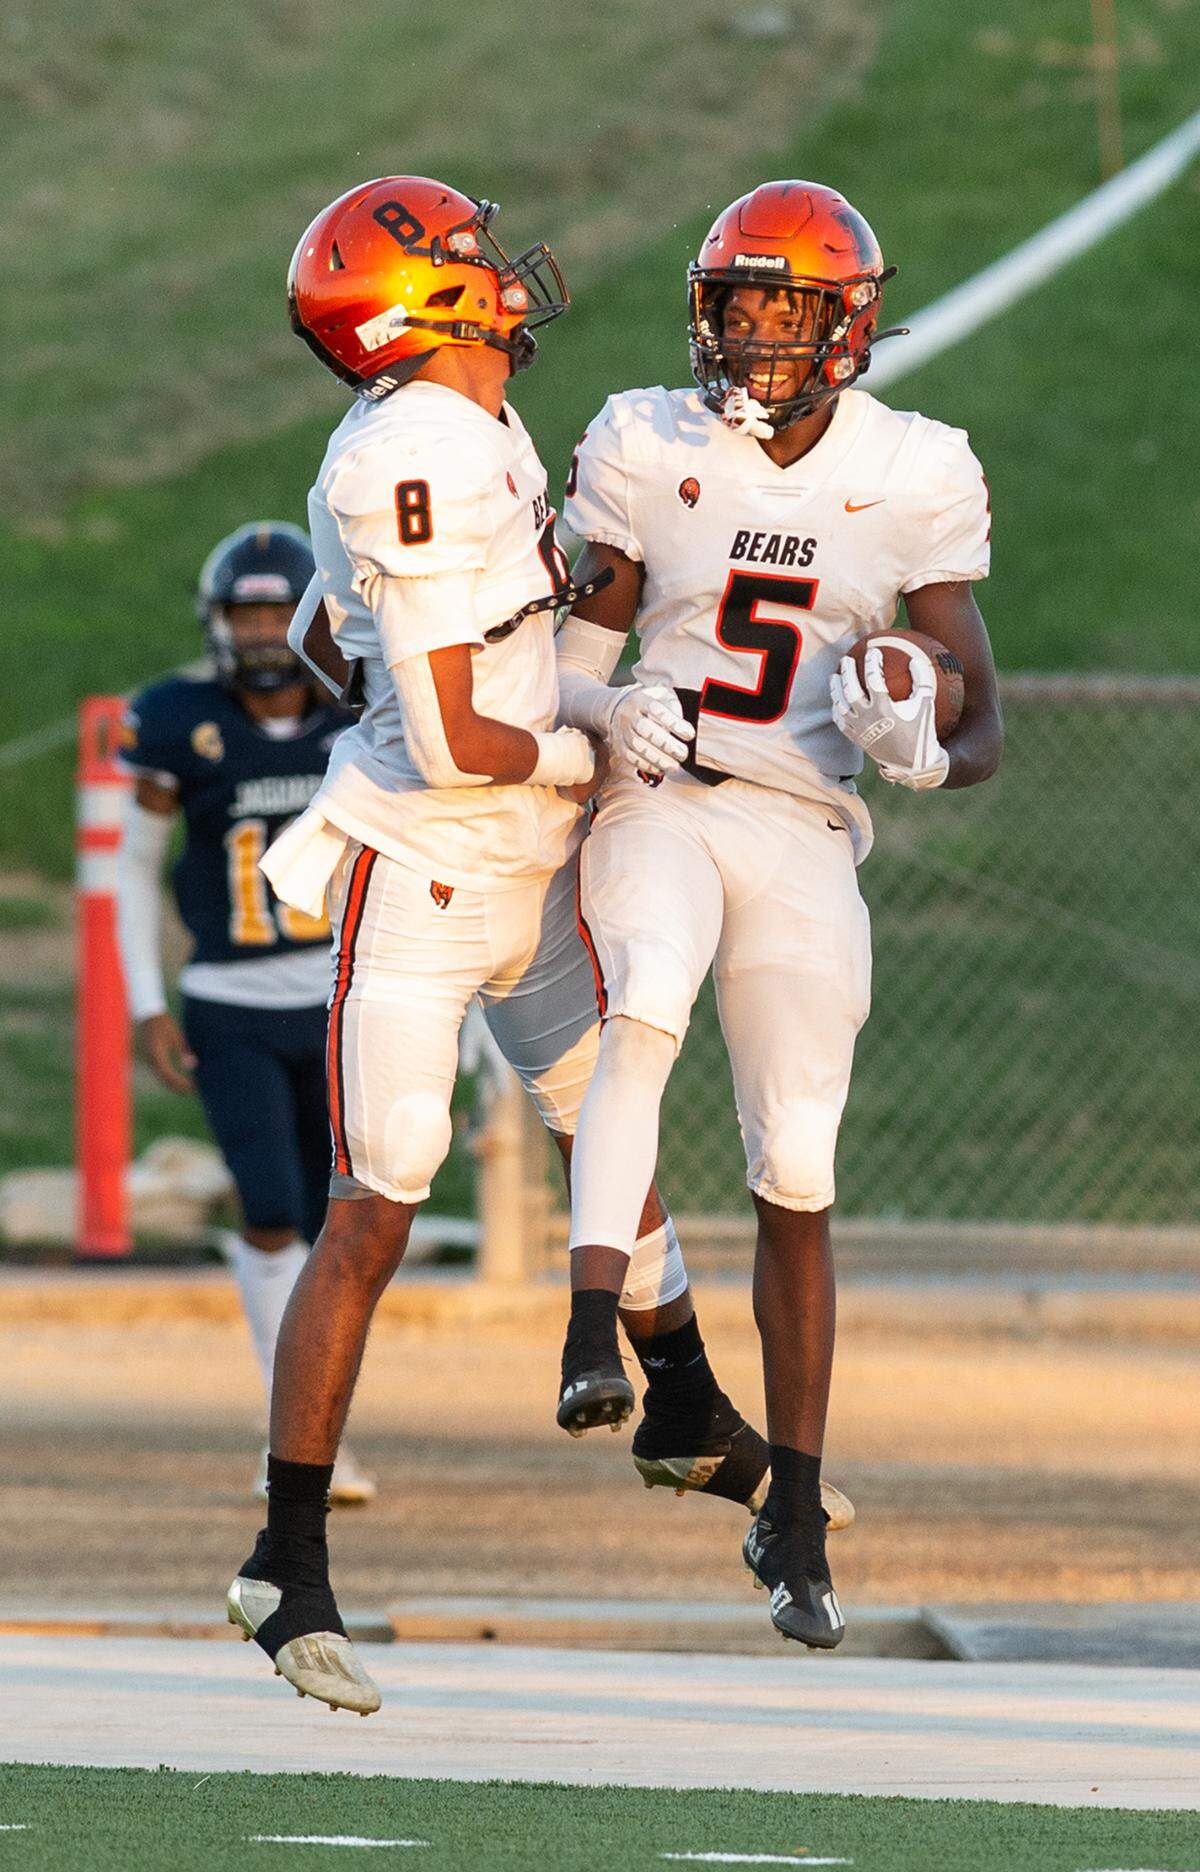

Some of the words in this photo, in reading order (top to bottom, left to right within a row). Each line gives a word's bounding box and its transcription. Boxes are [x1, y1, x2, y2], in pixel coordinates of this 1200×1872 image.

[373, 201, 425, 247] 8
[735, 254, 785, 269] Riddell
[395, 478, 434, 546] 8
[729, 530, 818, 567] BEARS
[700, 568, 820, 725] 5
